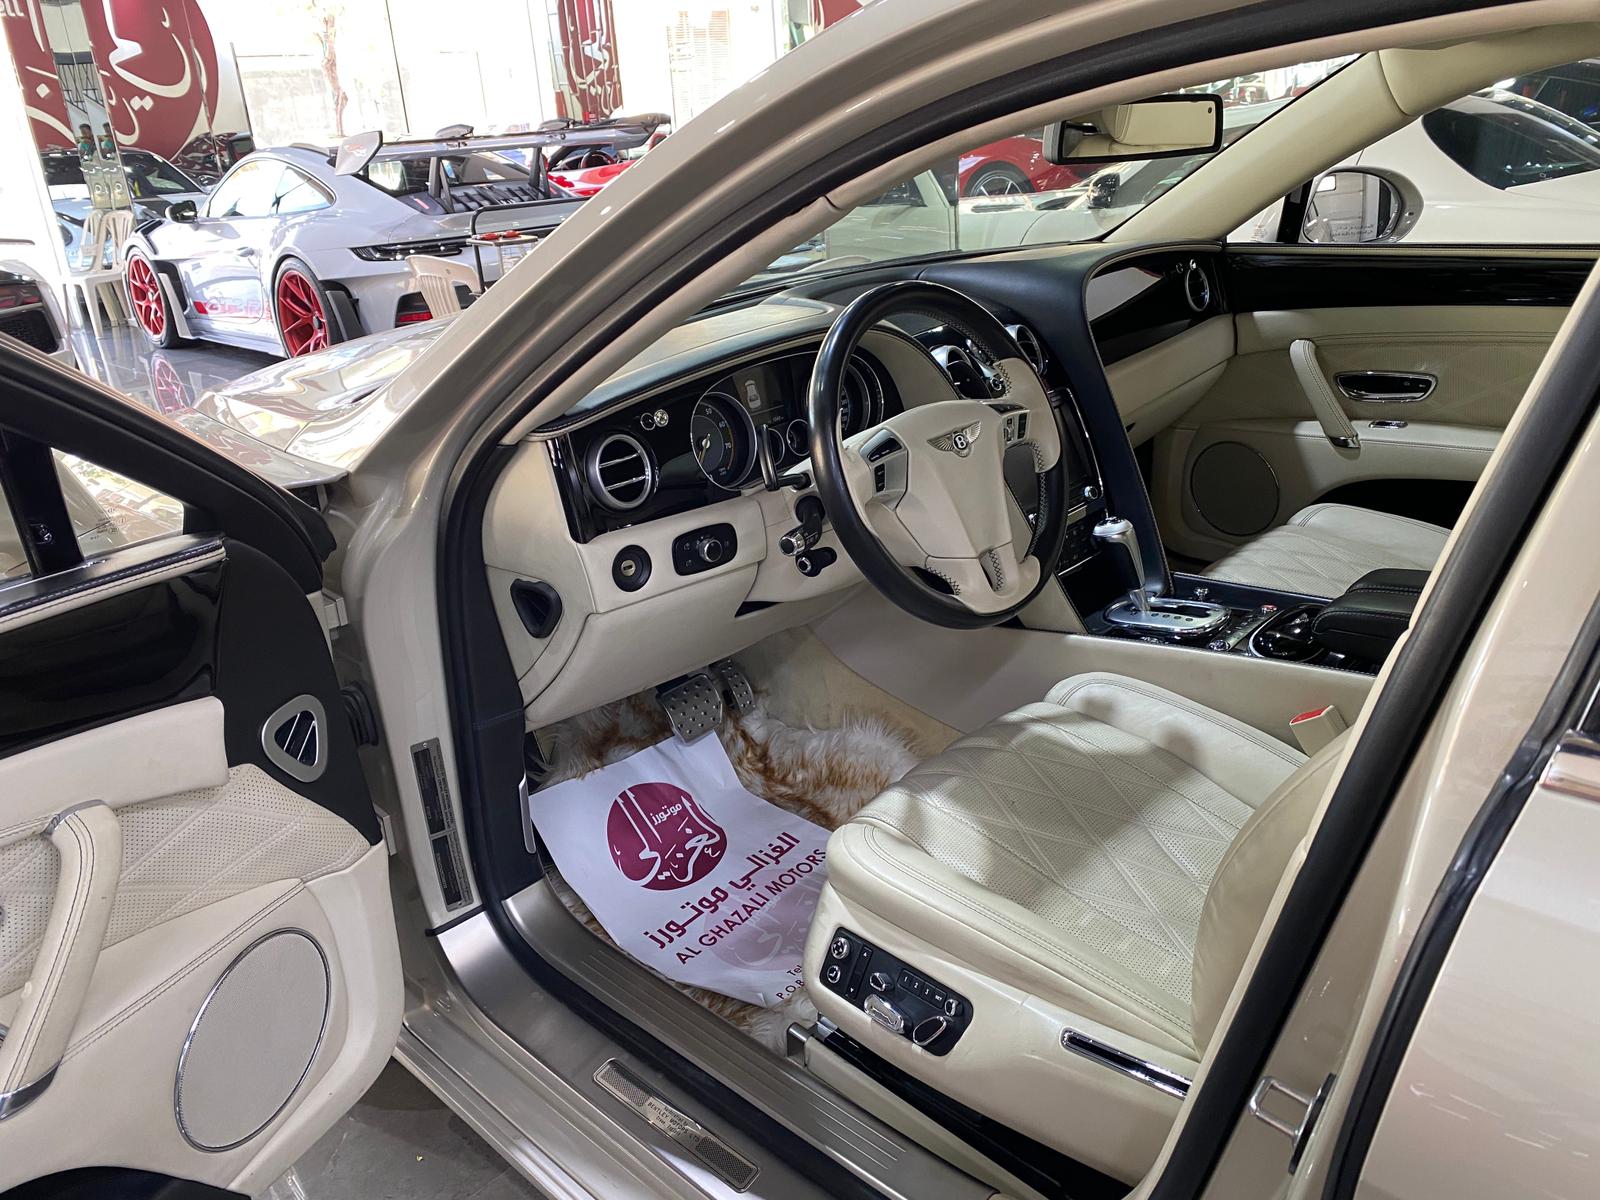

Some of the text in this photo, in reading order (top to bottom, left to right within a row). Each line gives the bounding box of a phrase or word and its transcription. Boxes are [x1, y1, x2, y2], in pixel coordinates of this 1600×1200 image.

[650, 803, 683, 826] موتورز
[643, 886, 729, 950] موتورز
[675, 946, 702, 965] AL
[698, 892, 770, 947] GHAZALI
[765, 849, 826, 896] MOTORS
[647, 1101, 669, 1119] BENTLEY
